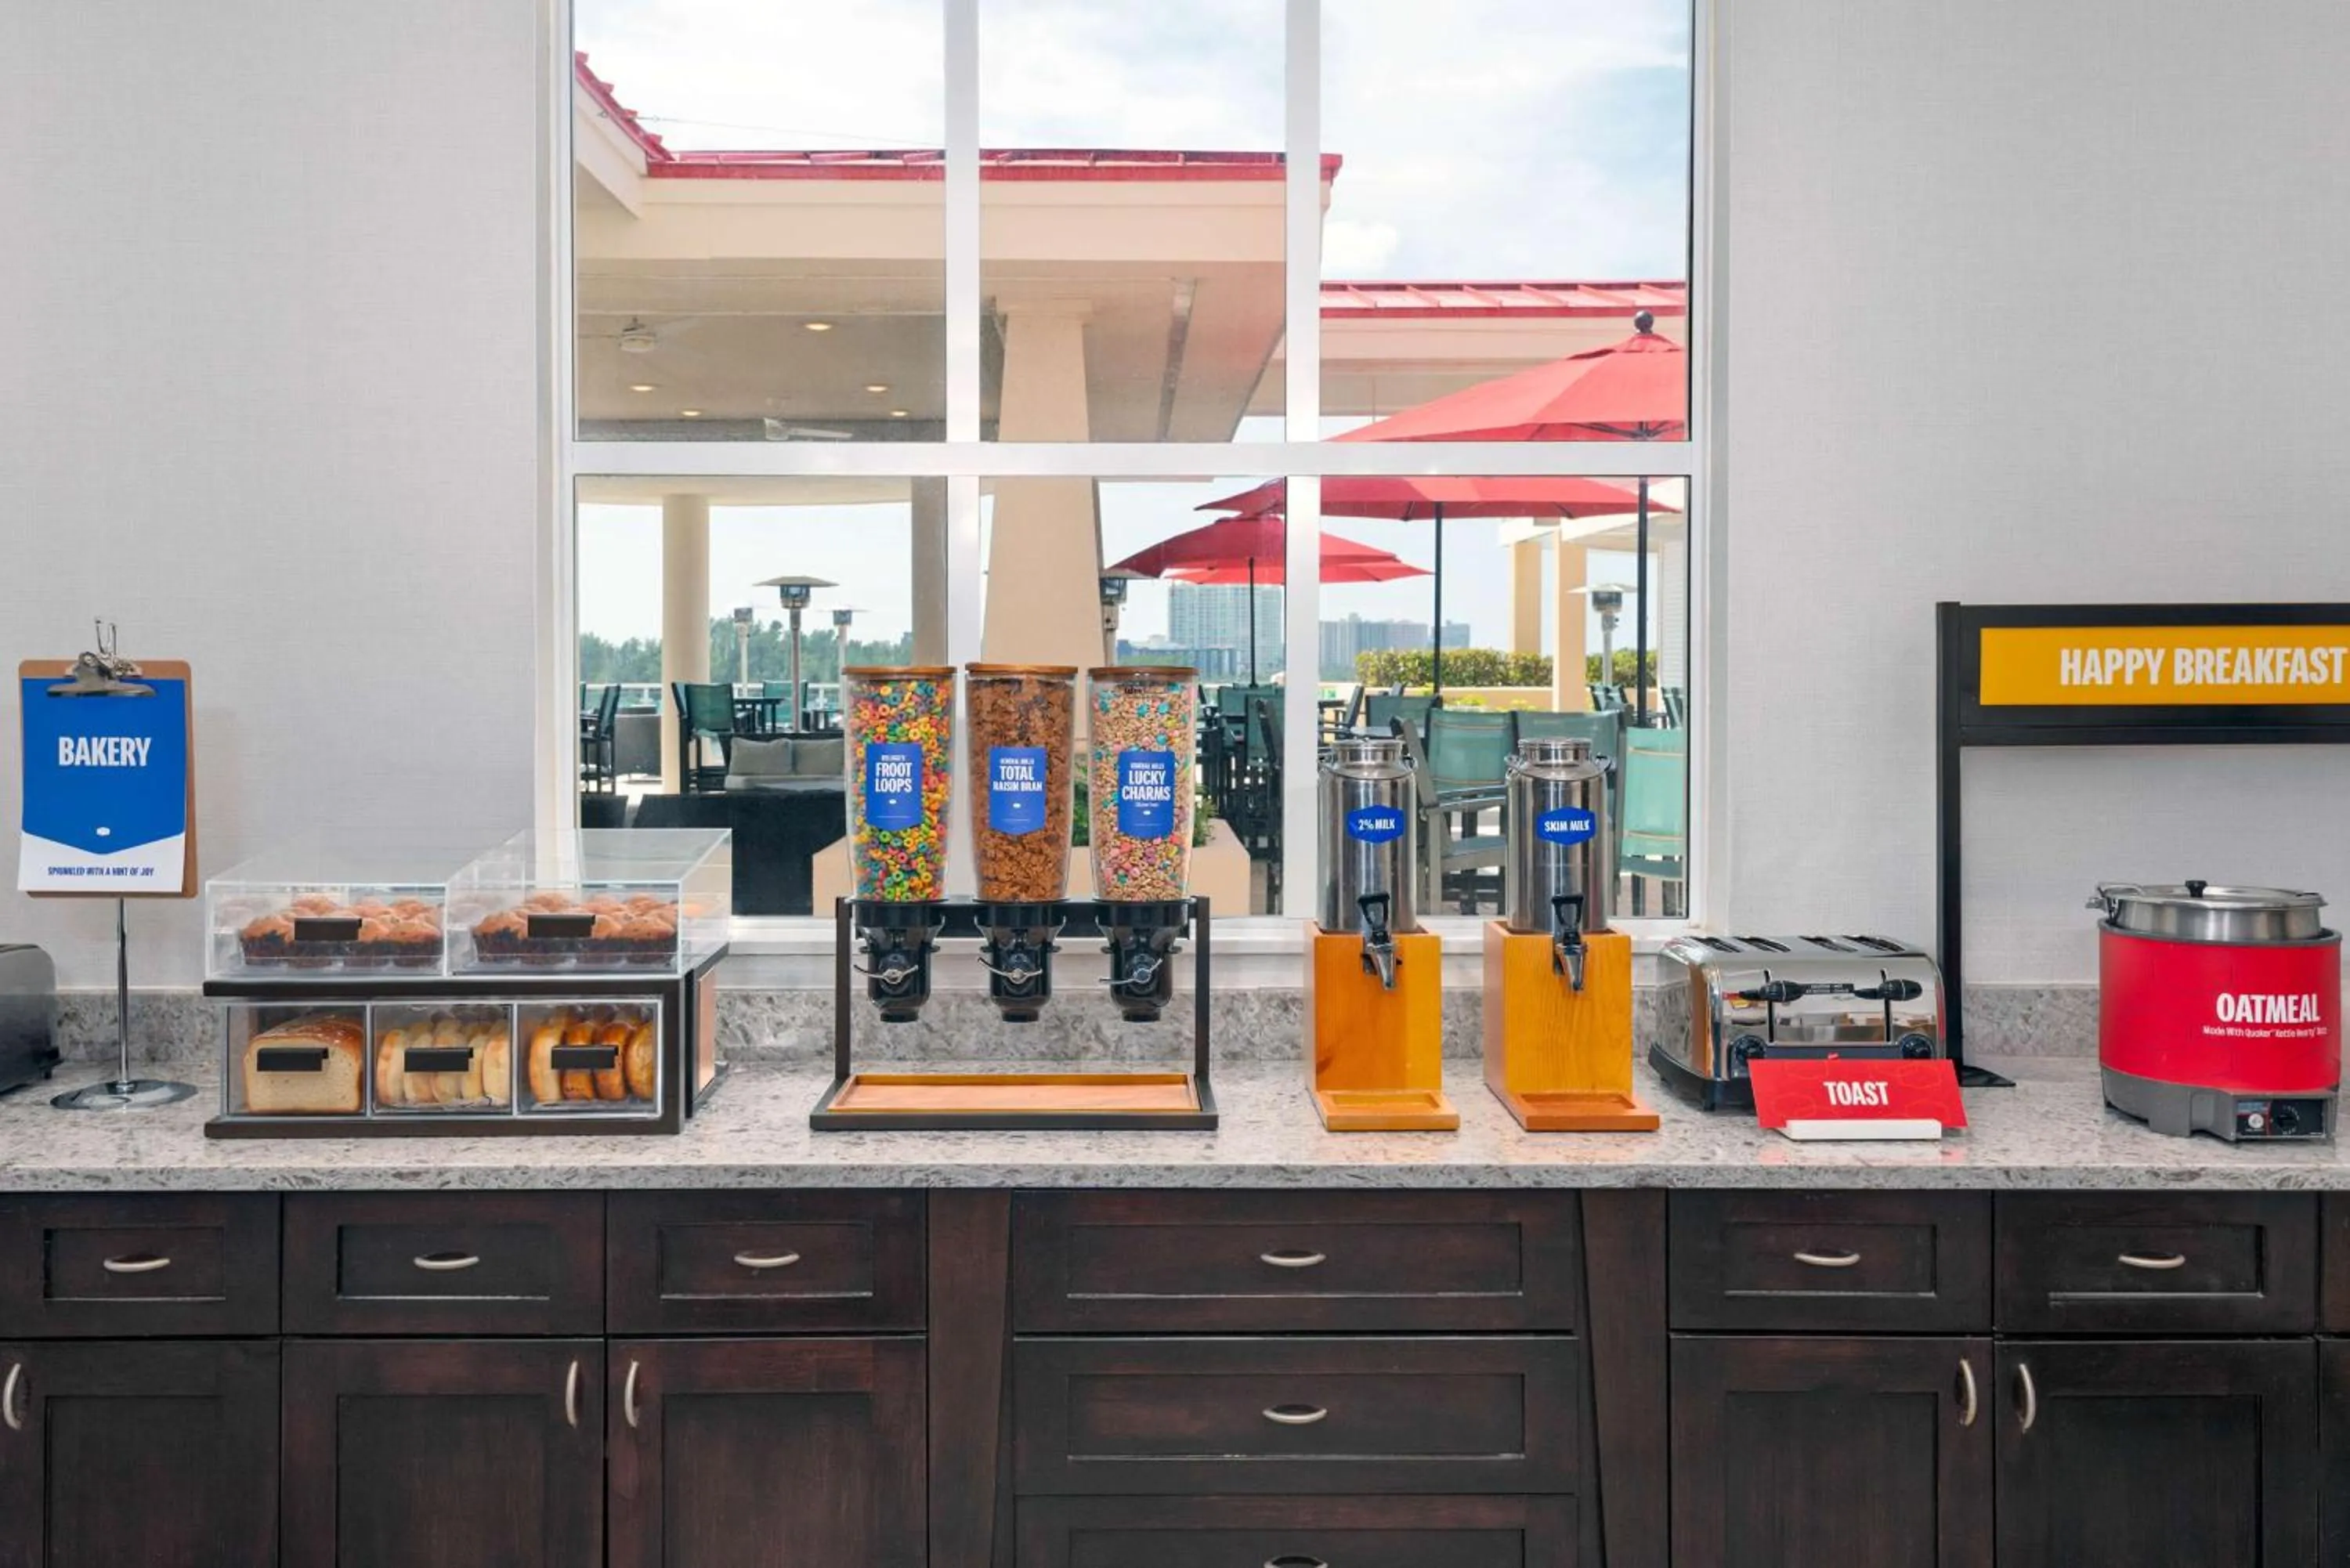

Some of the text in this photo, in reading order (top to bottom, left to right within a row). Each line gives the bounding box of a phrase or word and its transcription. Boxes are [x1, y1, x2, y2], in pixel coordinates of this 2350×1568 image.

[2059, 647, 2348, 686] HAPPY BREAKFAST
[59, 736, 152, 767] BAKERY
[875, 762, 913, 777] FROOT
[1000, 765, 1035, 780] TOTAL
[875, 778, 913, 793] LOOPS
[1129, 770, 1166, 786] LUCKY
[992, 781, 1043, 792] RAISIN BRAN
[1122, 786, 1171, 801] CHARMS
[1358, 818, 1395, 830] 2% MILK
[1544, 819, 1589, 832] SKIM MILK
[86, 866, 104, 876] WITH
[106, 867, 110, 876] A
[129, 867, 139, 876] OF
[141, 867, 154, 876] JOY
[2216, 992, 2321, 1024] OATMEAL
[2203, 1025, 2225, 1035] Made
[2226, 1027, 2244, 1036] With
[1823, 1081, 1889, 1105] TOAST
